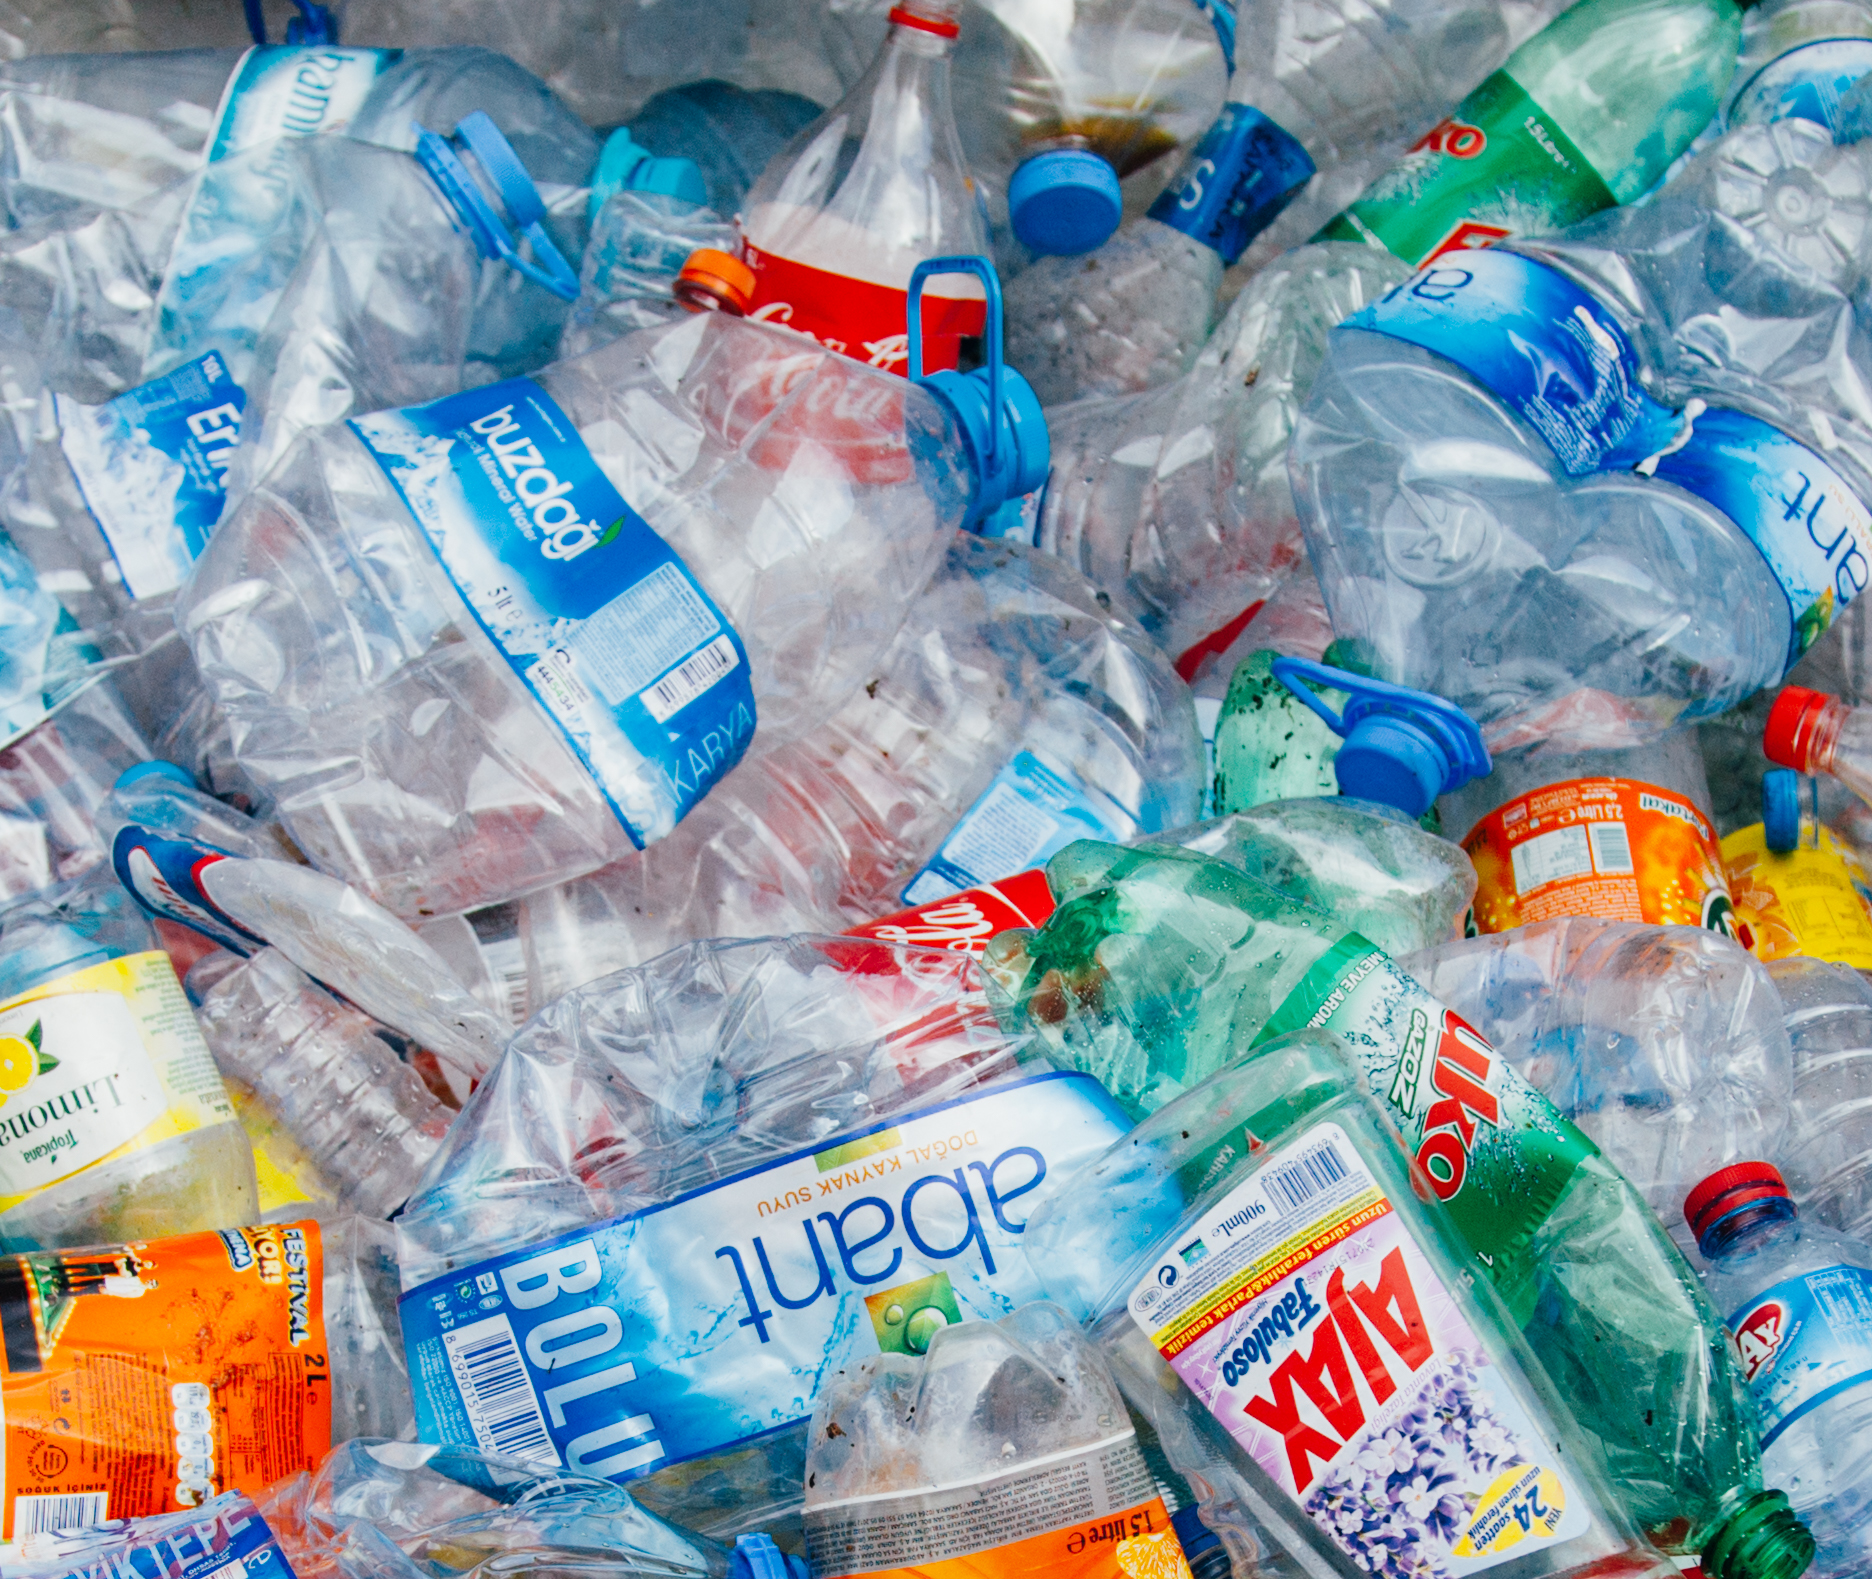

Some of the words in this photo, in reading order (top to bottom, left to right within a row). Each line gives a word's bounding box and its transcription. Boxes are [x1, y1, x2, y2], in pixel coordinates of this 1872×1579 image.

[469, 404, 604, 563] buzdağı
[1389, 1011, 1428, 1115] GAZOZ
[21, 1126, 81, 1166] Tropicana
[917, 1129, 979, 1161] DOĞAL
[816, 1154, 905, 1196] KAYNAK
[755, 1186, 815, 1218] SUYU
[1351, 1203, 1388, 1227] Uzun
[715, 1143, 1049, 1344] abant
[1311, 1222, 1351, 1252] süren
[1167, 1314, 1211, 1355] temizlik
[1222, 1277, 1322, 1388] Fabuloso
[499, 1238, 666, 1479] BOLU
[1243, 1245, 1435, 1495] AJAX
[1508, 1484, 1555, 1531] 24
[1471, 1511, 1516, 1553] saatten
